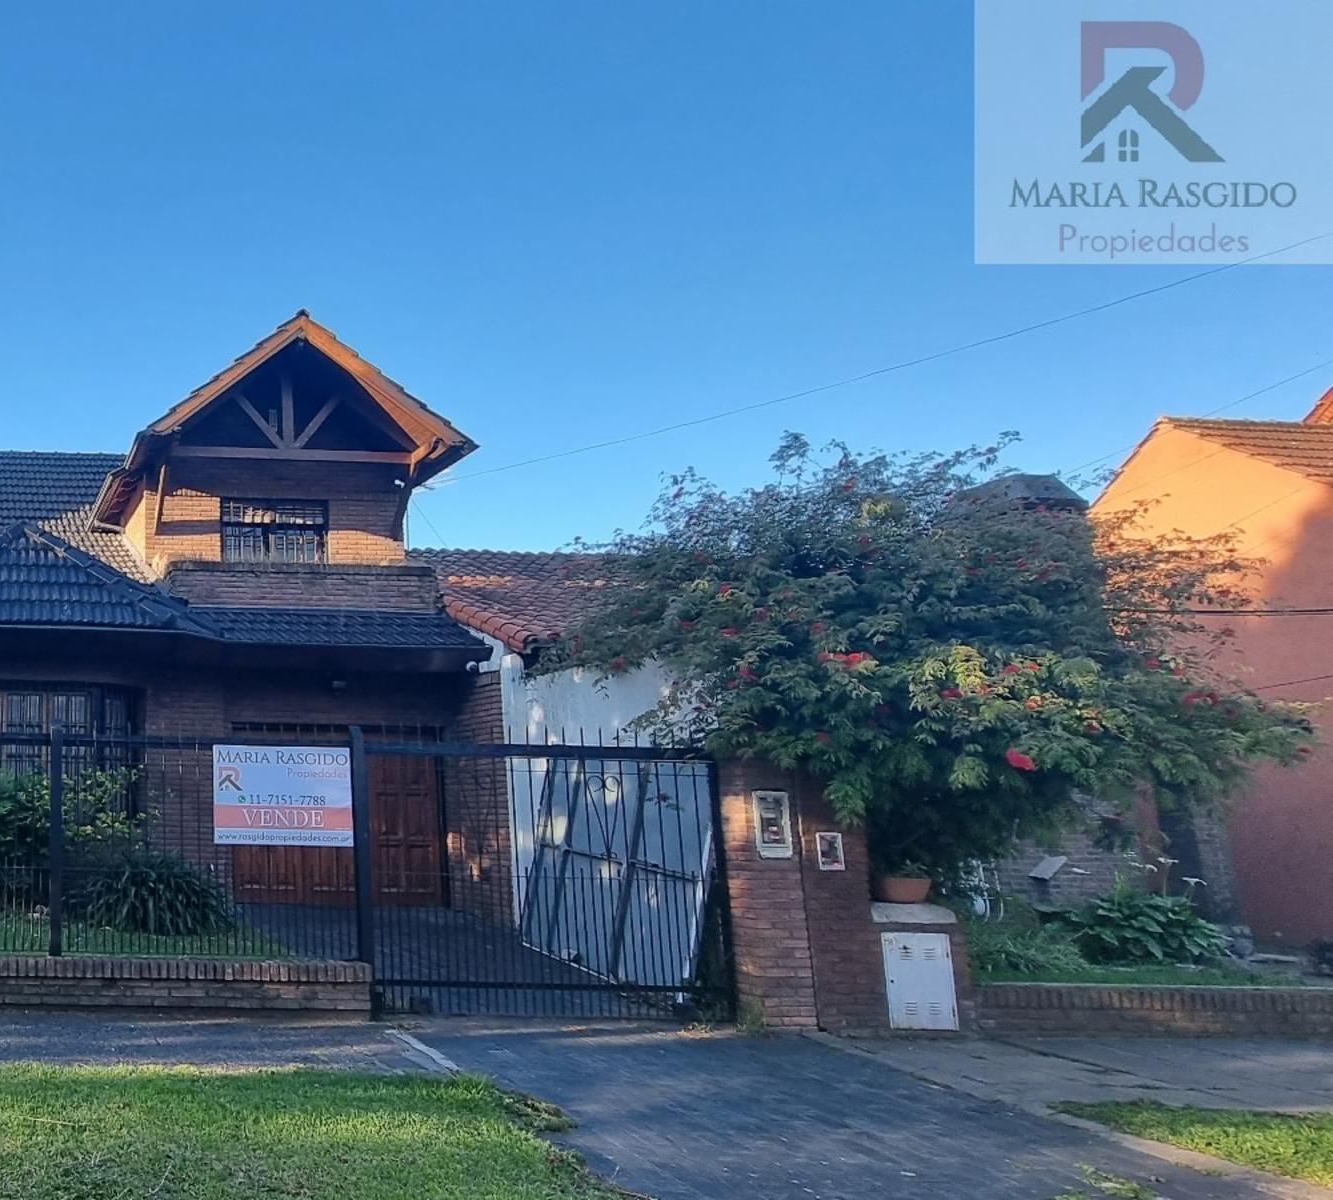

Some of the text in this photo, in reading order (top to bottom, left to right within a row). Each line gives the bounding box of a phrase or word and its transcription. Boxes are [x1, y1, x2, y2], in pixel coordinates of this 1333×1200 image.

[217, 750, 348, 766] MARIA RASGIDO
[287, 768, 348, 779] Propiedades
[249, 794, 326, 806] 11-7151-7788
[242, 808, 325, 828] VENDE
[217, 831, 350, 843] www.rasgidopropiedades.com.ar
